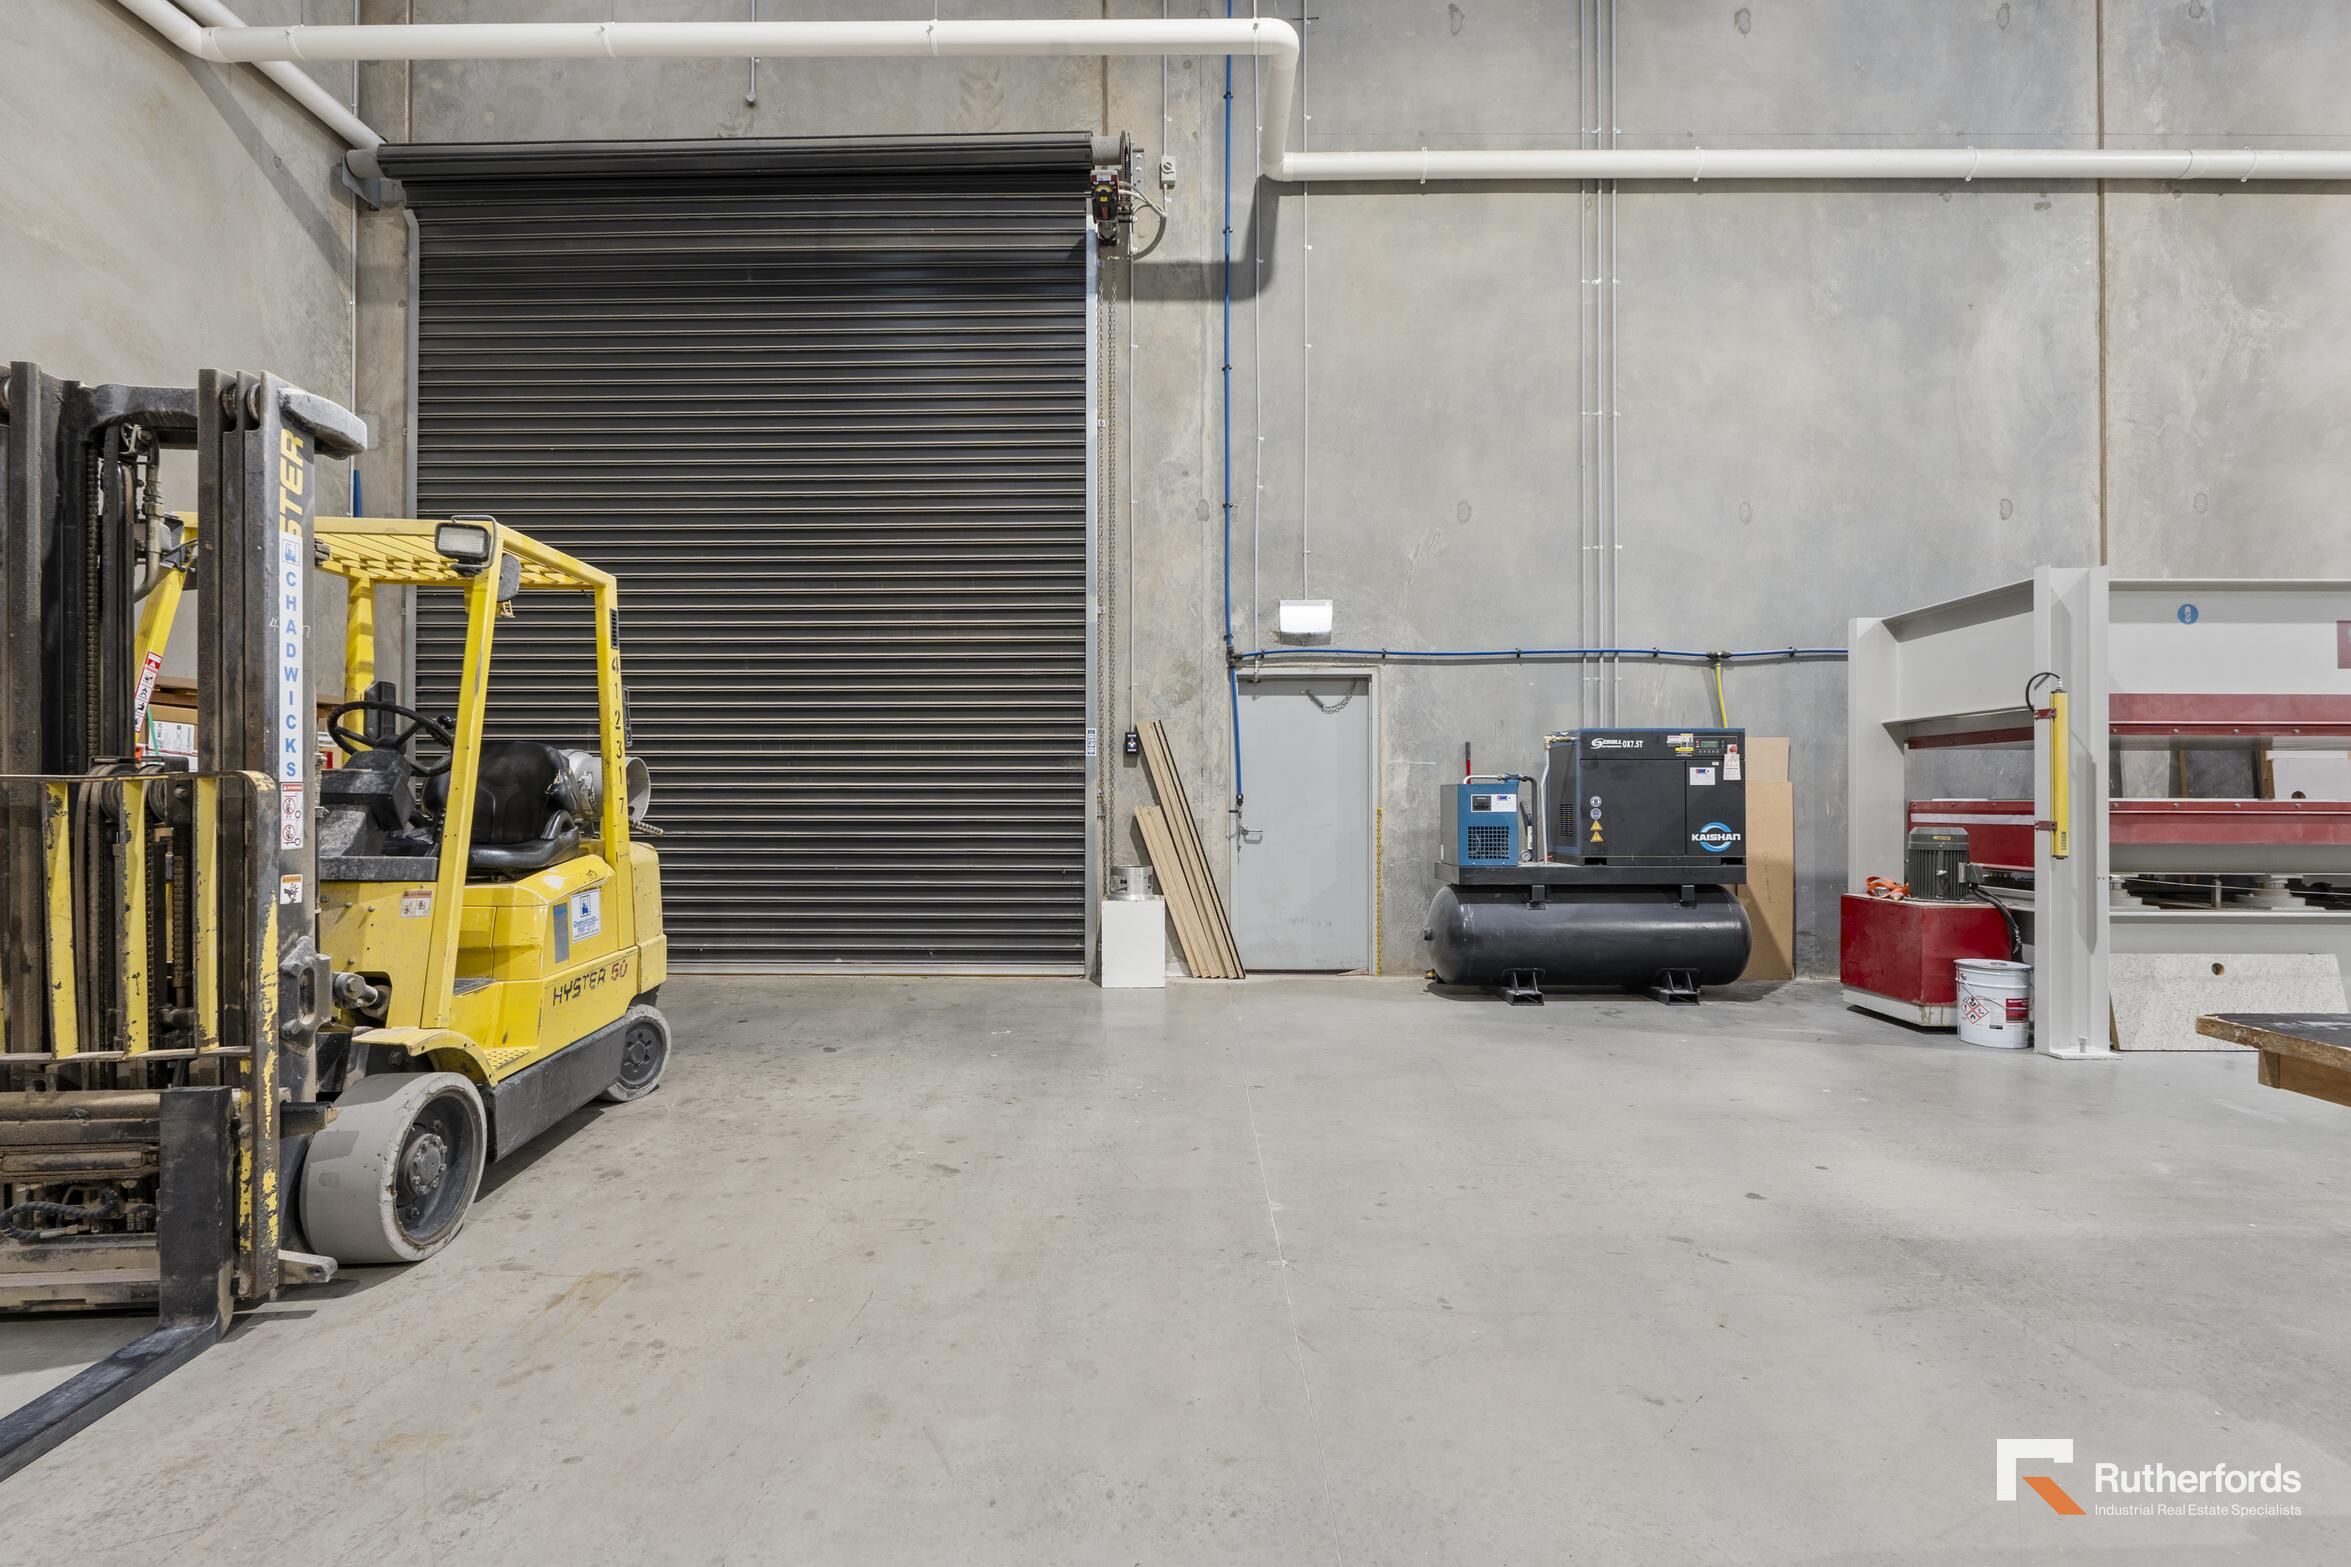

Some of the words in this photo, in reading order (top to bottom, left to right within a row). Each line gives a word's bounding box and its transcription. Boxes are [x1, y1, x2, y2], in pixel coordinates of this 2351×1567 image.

[284, 571, 298, 777] CHADWICKS
[1691, 833, 1741, 841] KAISHAN
[552, 968, 606, 1007] HYSTER
[610, 959, 628, 982] 50
